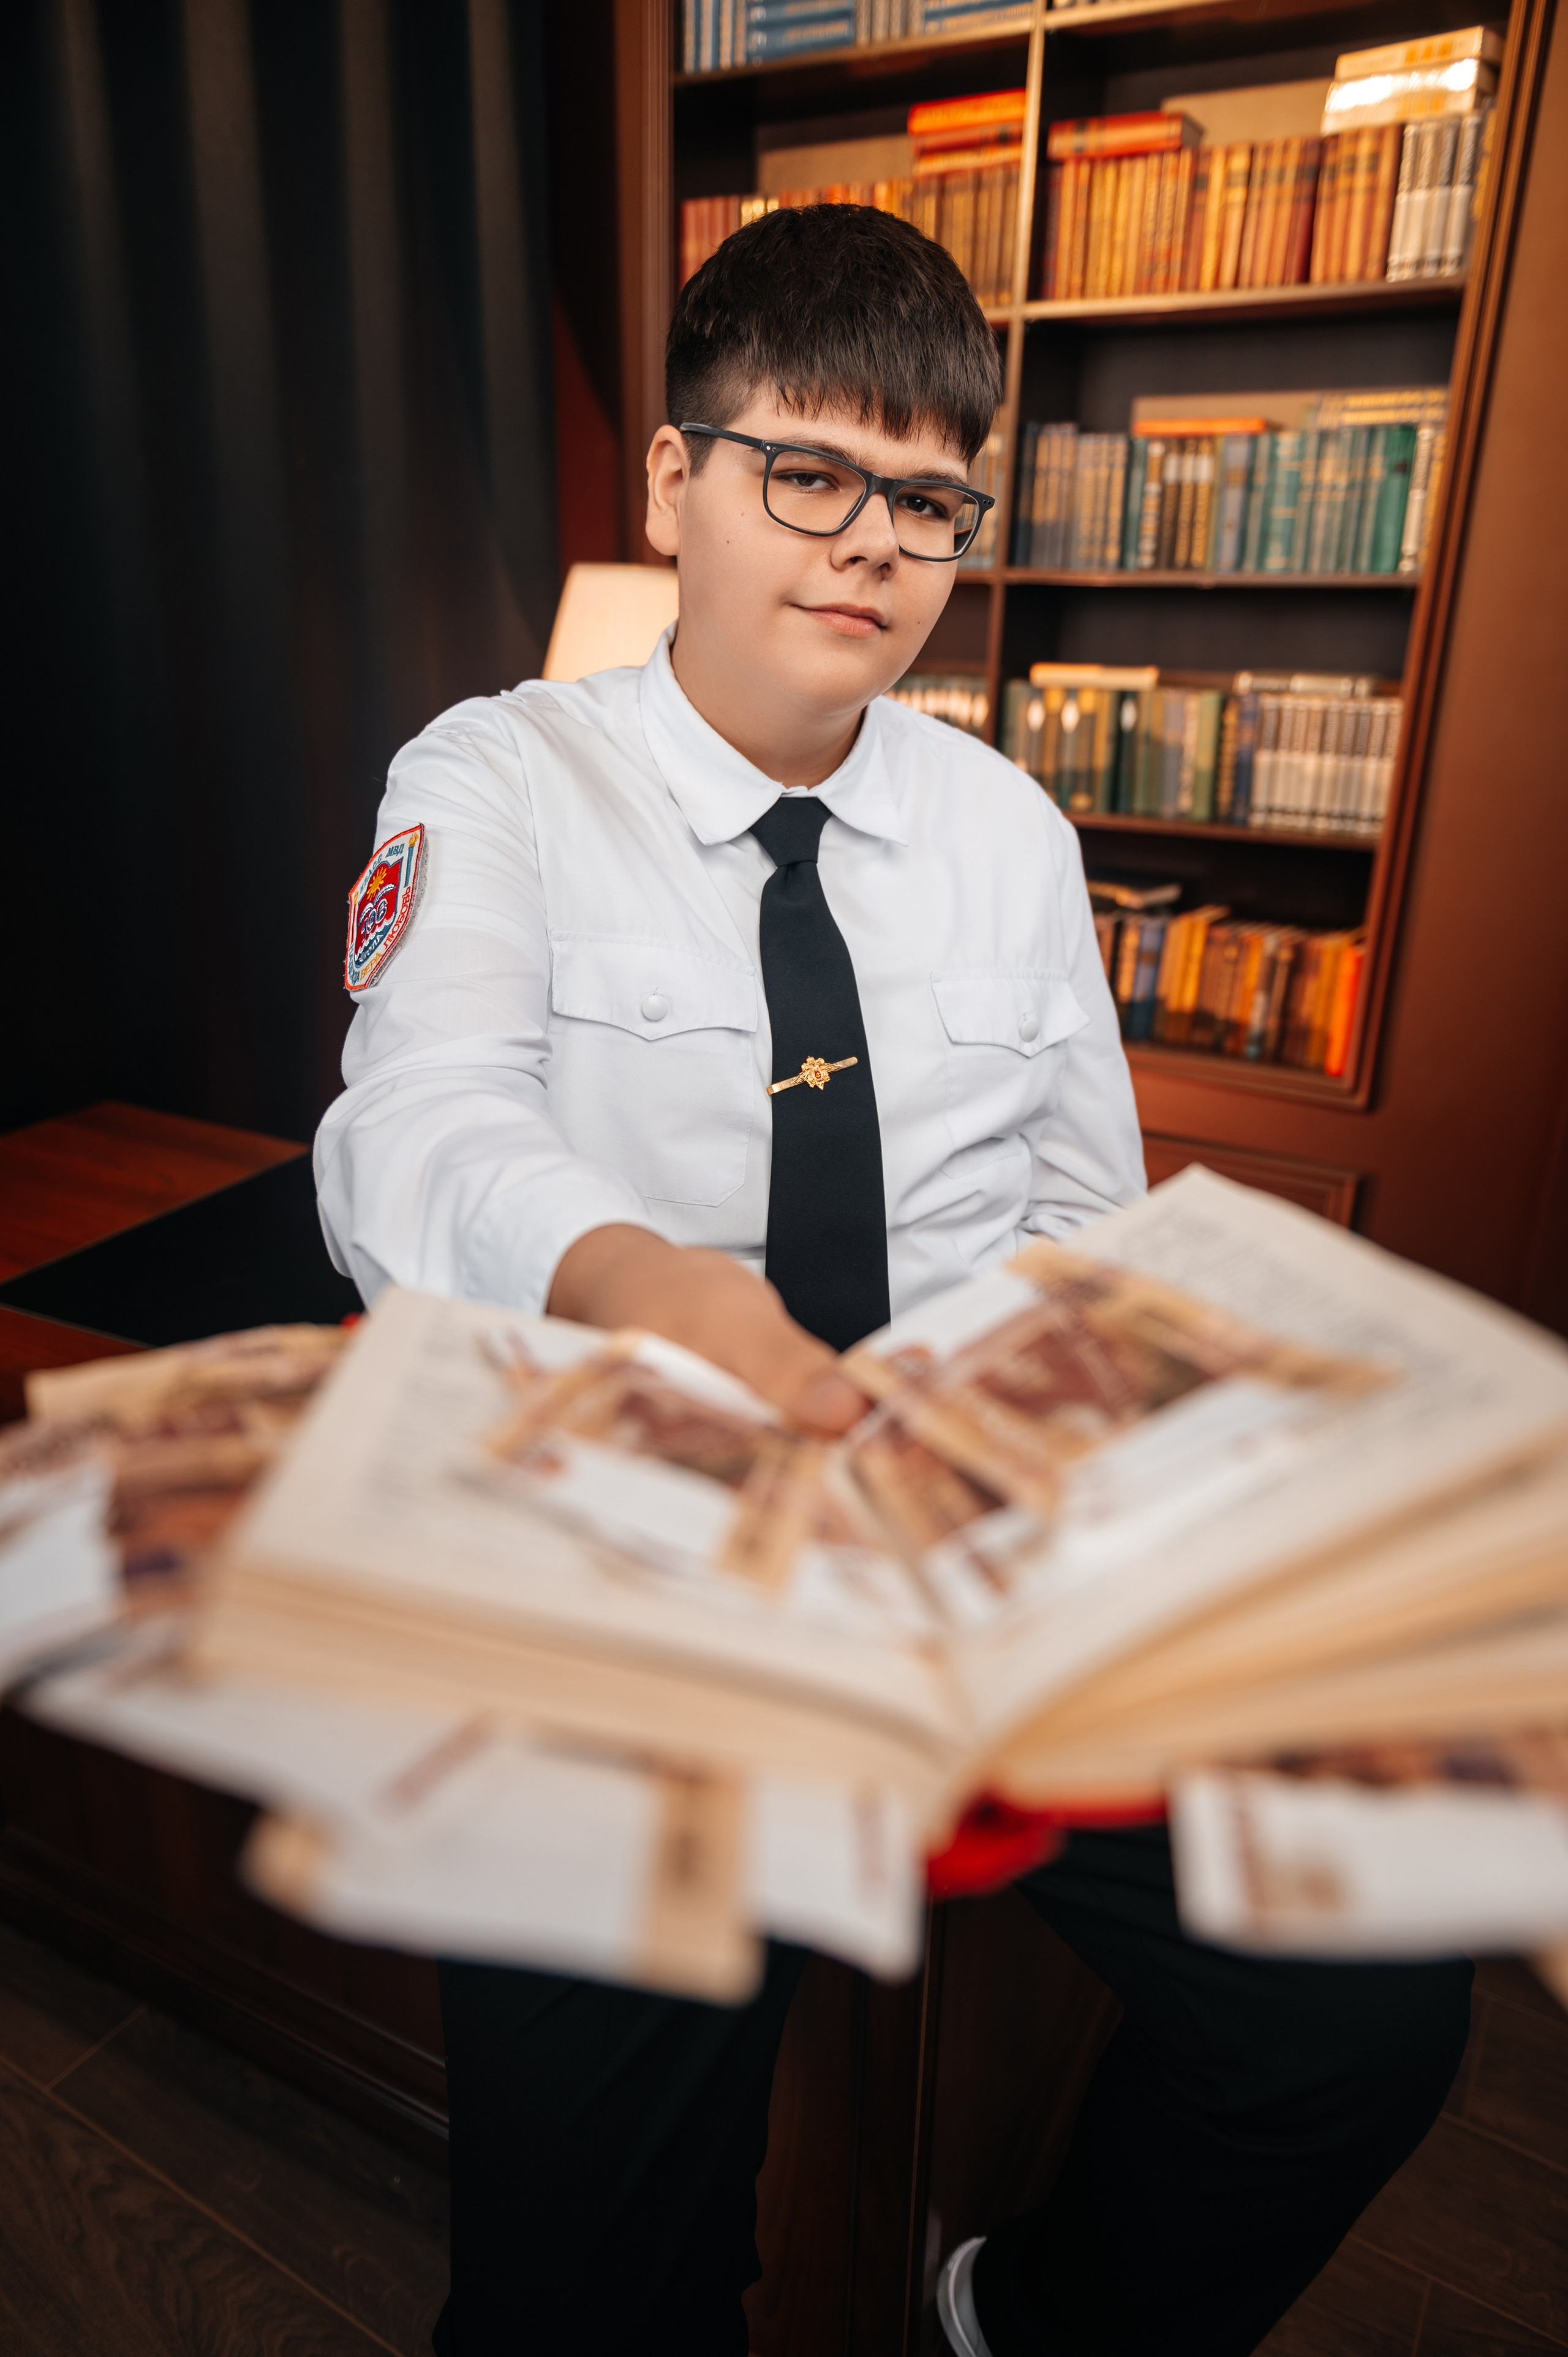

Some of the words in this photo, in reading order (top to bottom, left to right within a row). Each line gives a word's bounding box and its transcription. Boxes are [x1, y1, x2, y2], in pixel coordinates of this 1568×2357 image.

[360, 853, 383, 894] КЛАСС
[385, 843, 405, 858] МВД
[360, 952, 383, 981] ВЕРА
[383, 886, 411, 949] ЛЮБОВЬ
